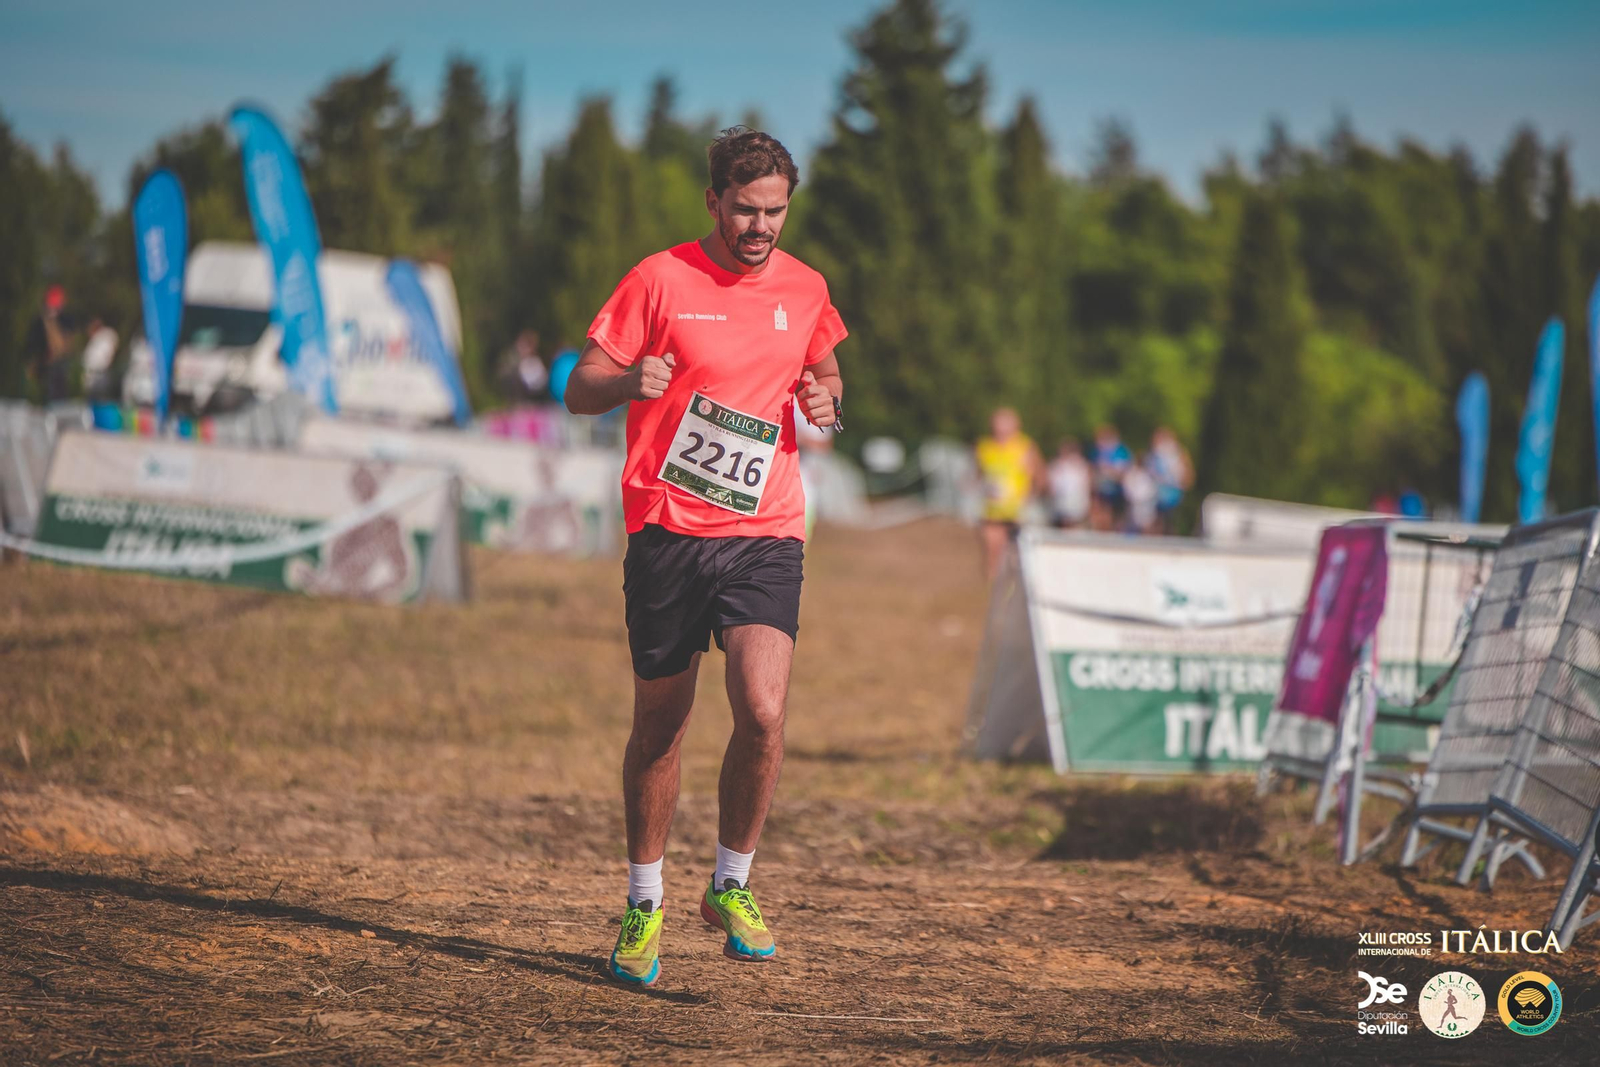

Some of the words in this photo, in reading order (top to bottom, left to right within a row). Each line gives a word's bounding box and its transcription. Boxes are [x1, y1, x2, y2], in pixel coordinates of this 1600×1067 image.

[695, 313, 716, 321] Running
[716, 409, 759, 433] ITÁLICA
[678, 431, 765, 488] 2216
[1069, 656, 1177, 692] CROSS
